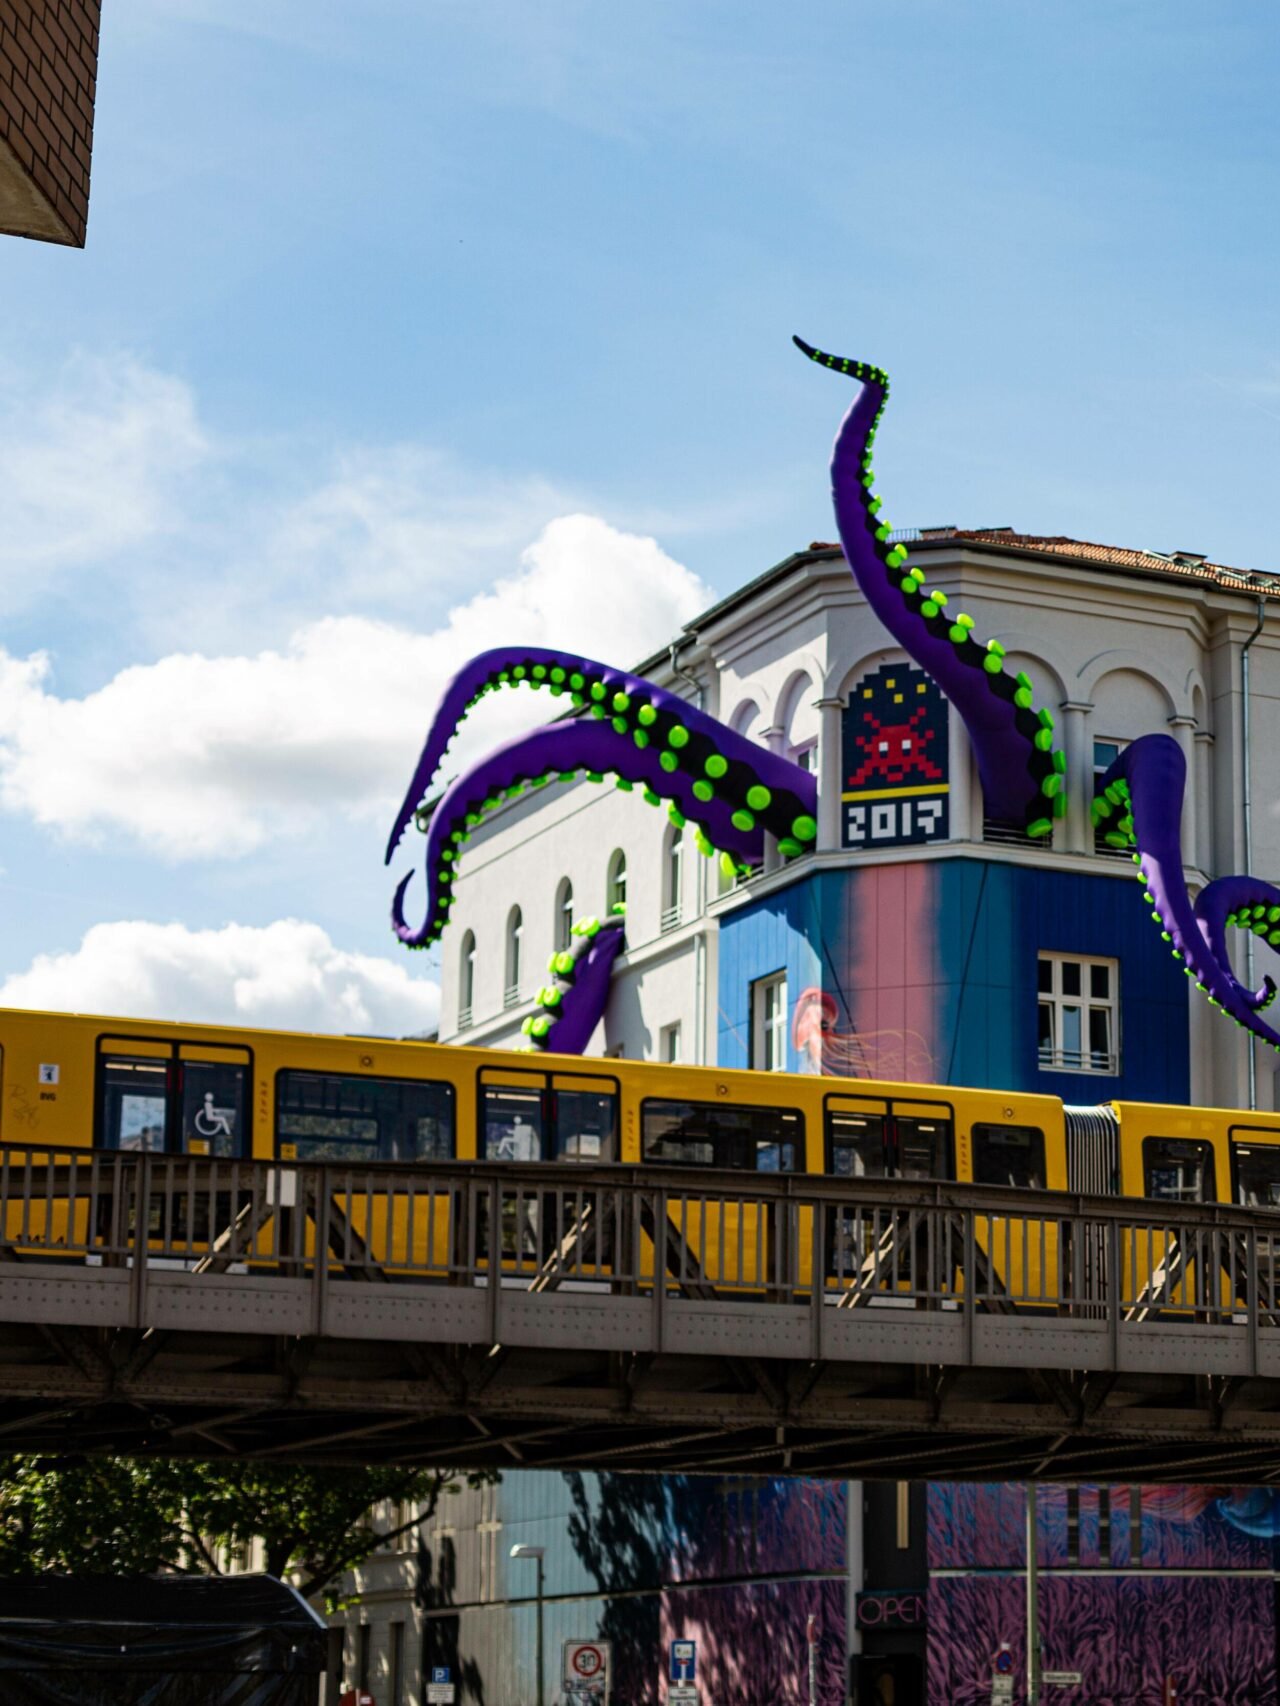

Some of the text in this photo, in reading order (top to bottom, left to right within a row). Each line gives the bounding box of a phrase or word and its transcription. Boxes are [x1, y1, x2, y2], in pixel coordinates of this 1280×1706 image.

[847, 800, 943, 841] 2017
[858, 1596, 927, 1624] OPEN
[435, 1670, 445, 1682] P
